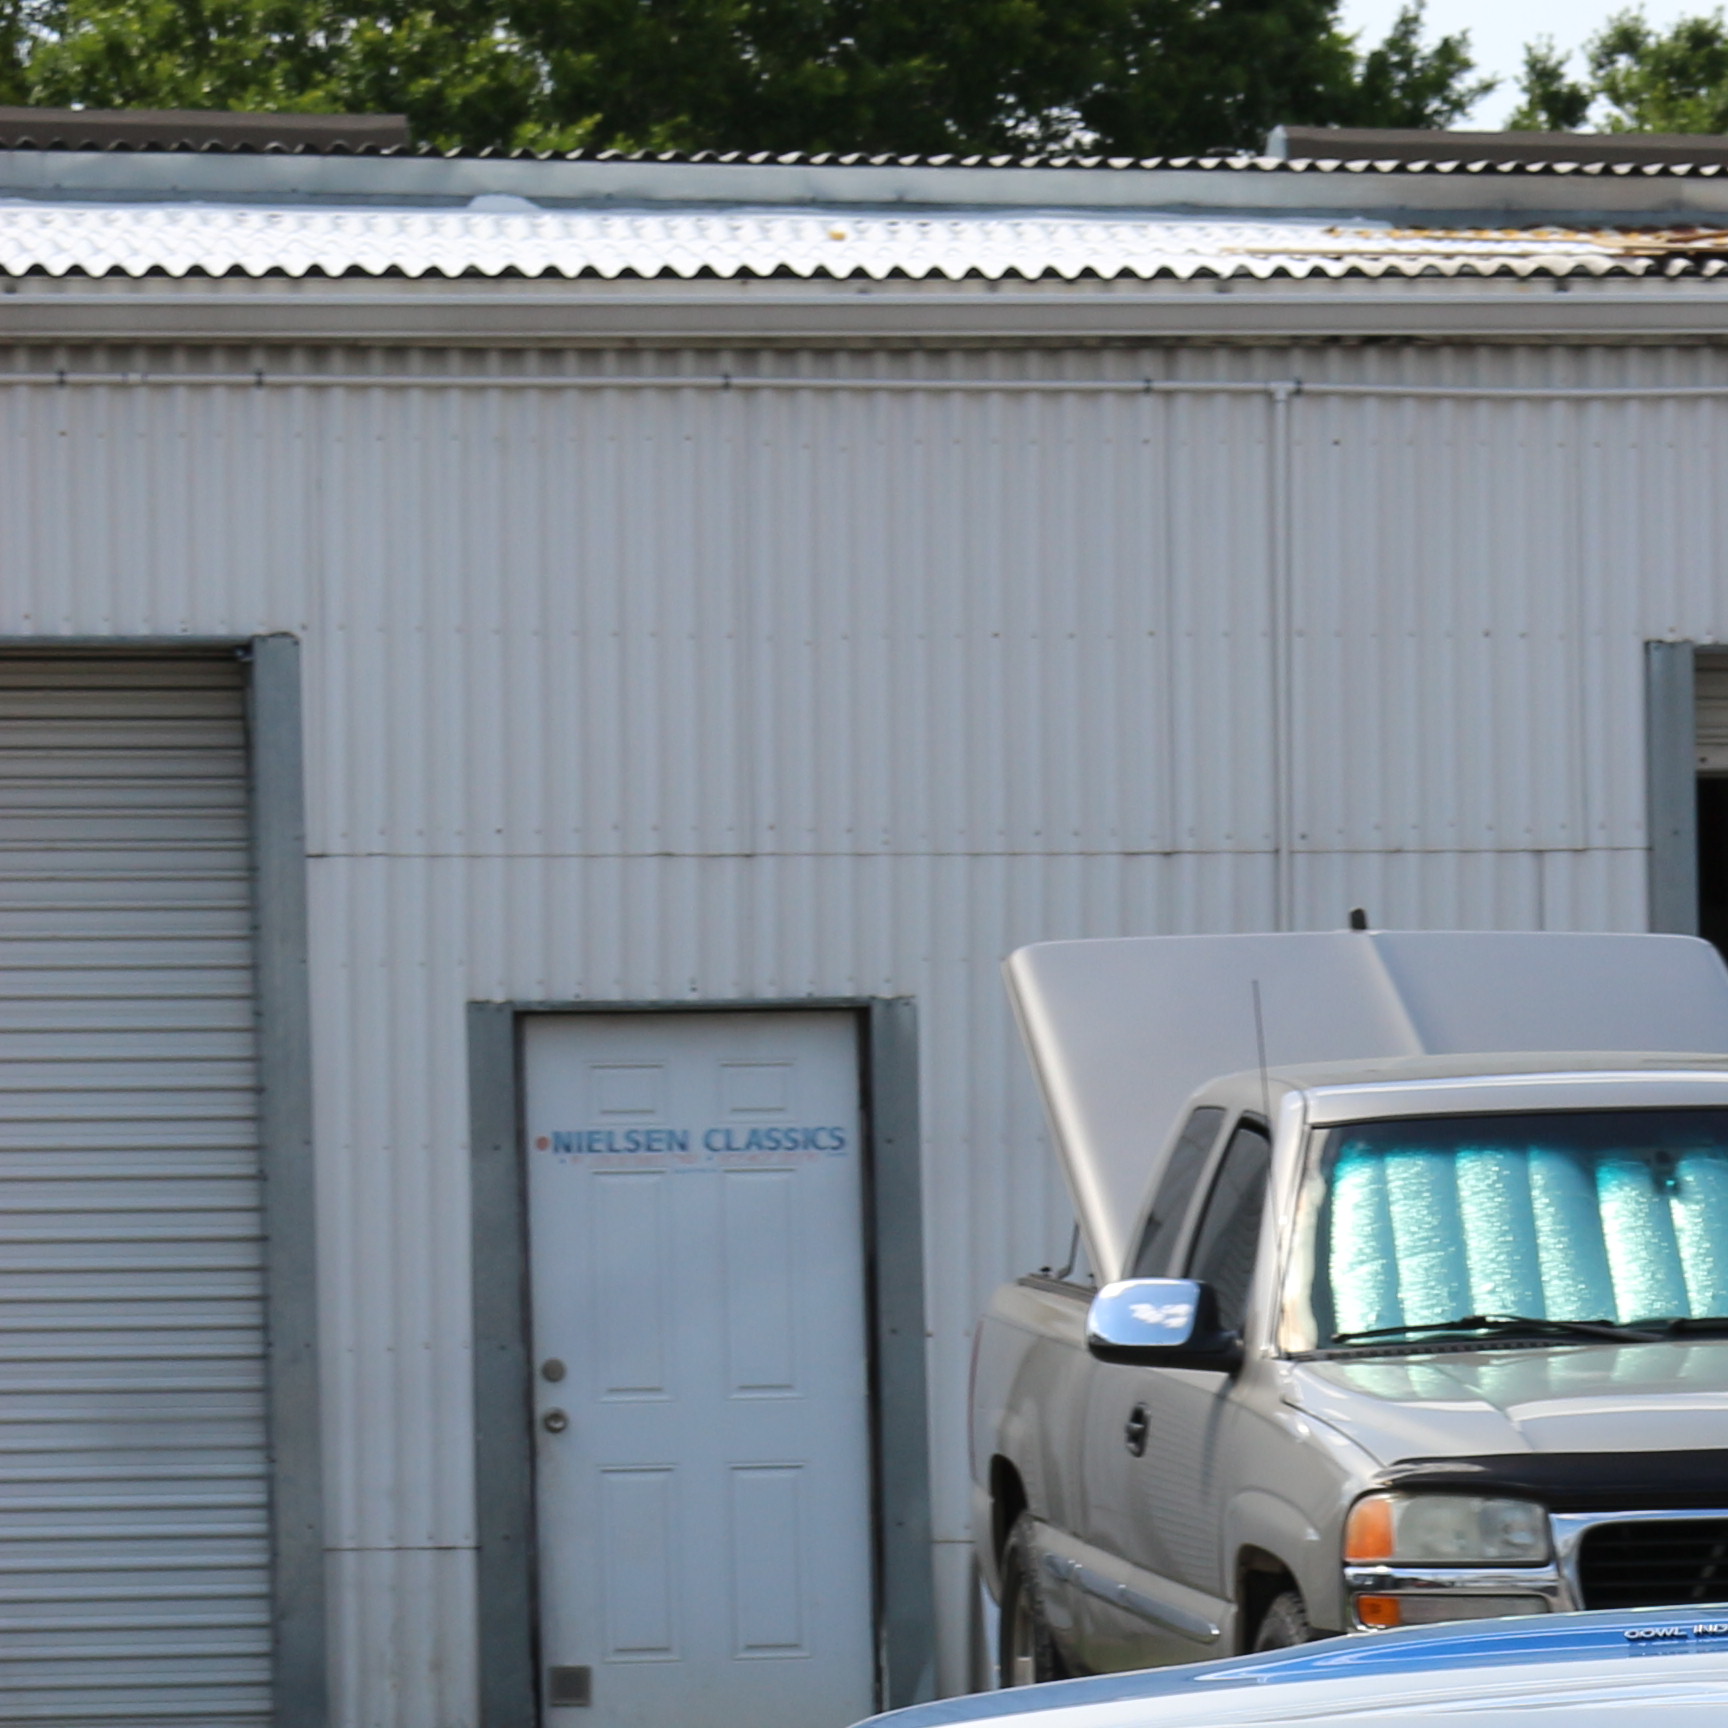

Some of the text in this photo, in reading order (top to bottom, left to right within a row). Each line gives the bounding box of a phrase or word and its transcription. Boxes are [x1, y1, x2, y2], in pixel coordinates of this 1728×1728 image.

[551, 1126, 846, 1153] NIELSEN CLASSICS
[1623, 1627, 1687, 1640] COWL
